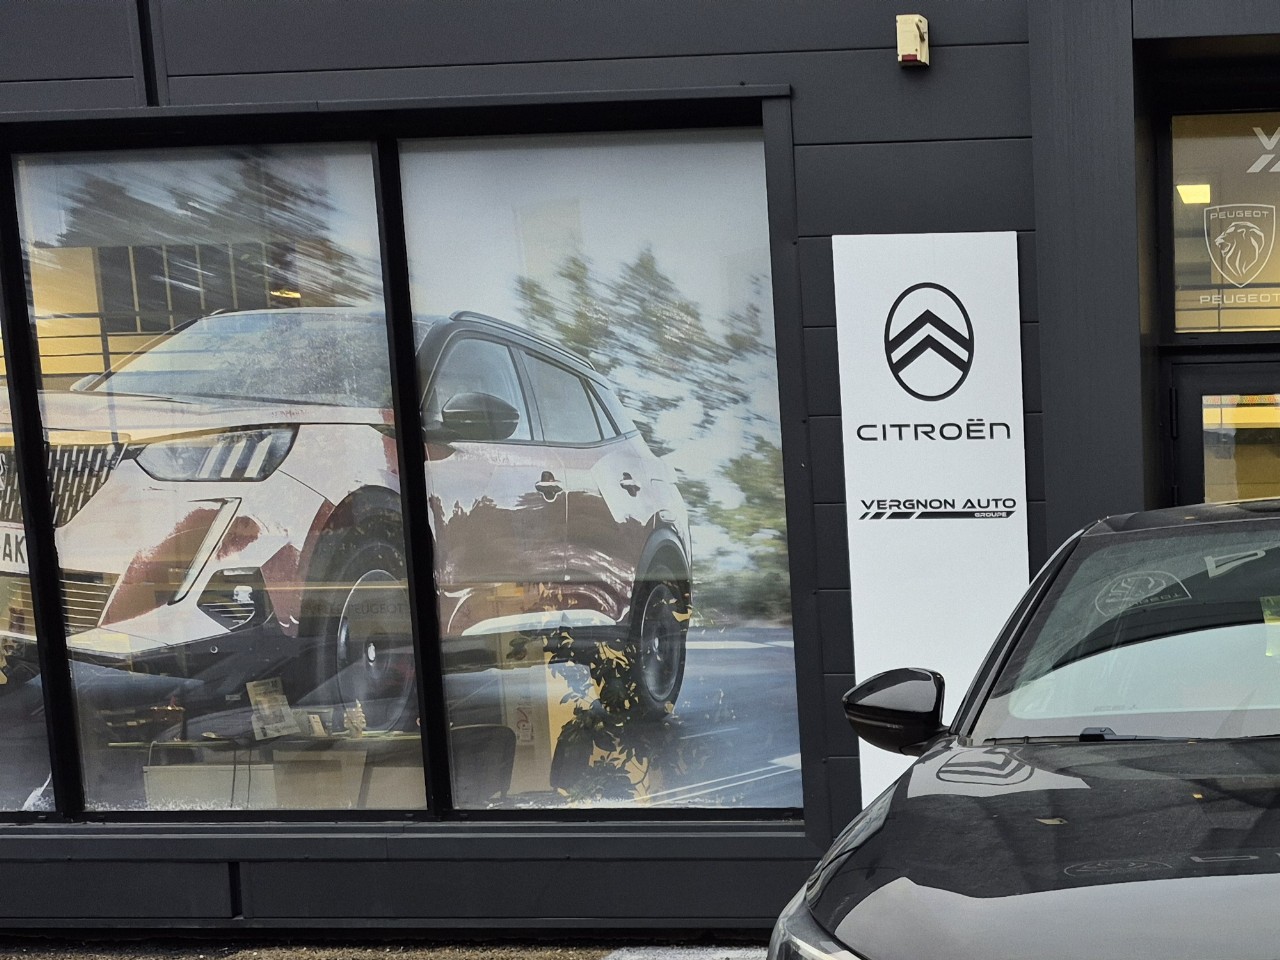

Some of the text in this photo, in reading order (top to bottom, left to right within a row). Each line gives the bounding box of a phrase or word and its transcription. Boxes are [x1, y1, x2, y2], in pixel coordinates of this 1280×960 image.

[1209, 210, 1270, 220] PEUGEOT
[1199, 293, 1280, 305] PEUGEOT
[860, 498, 1016, 510] VERGNON AUTO
